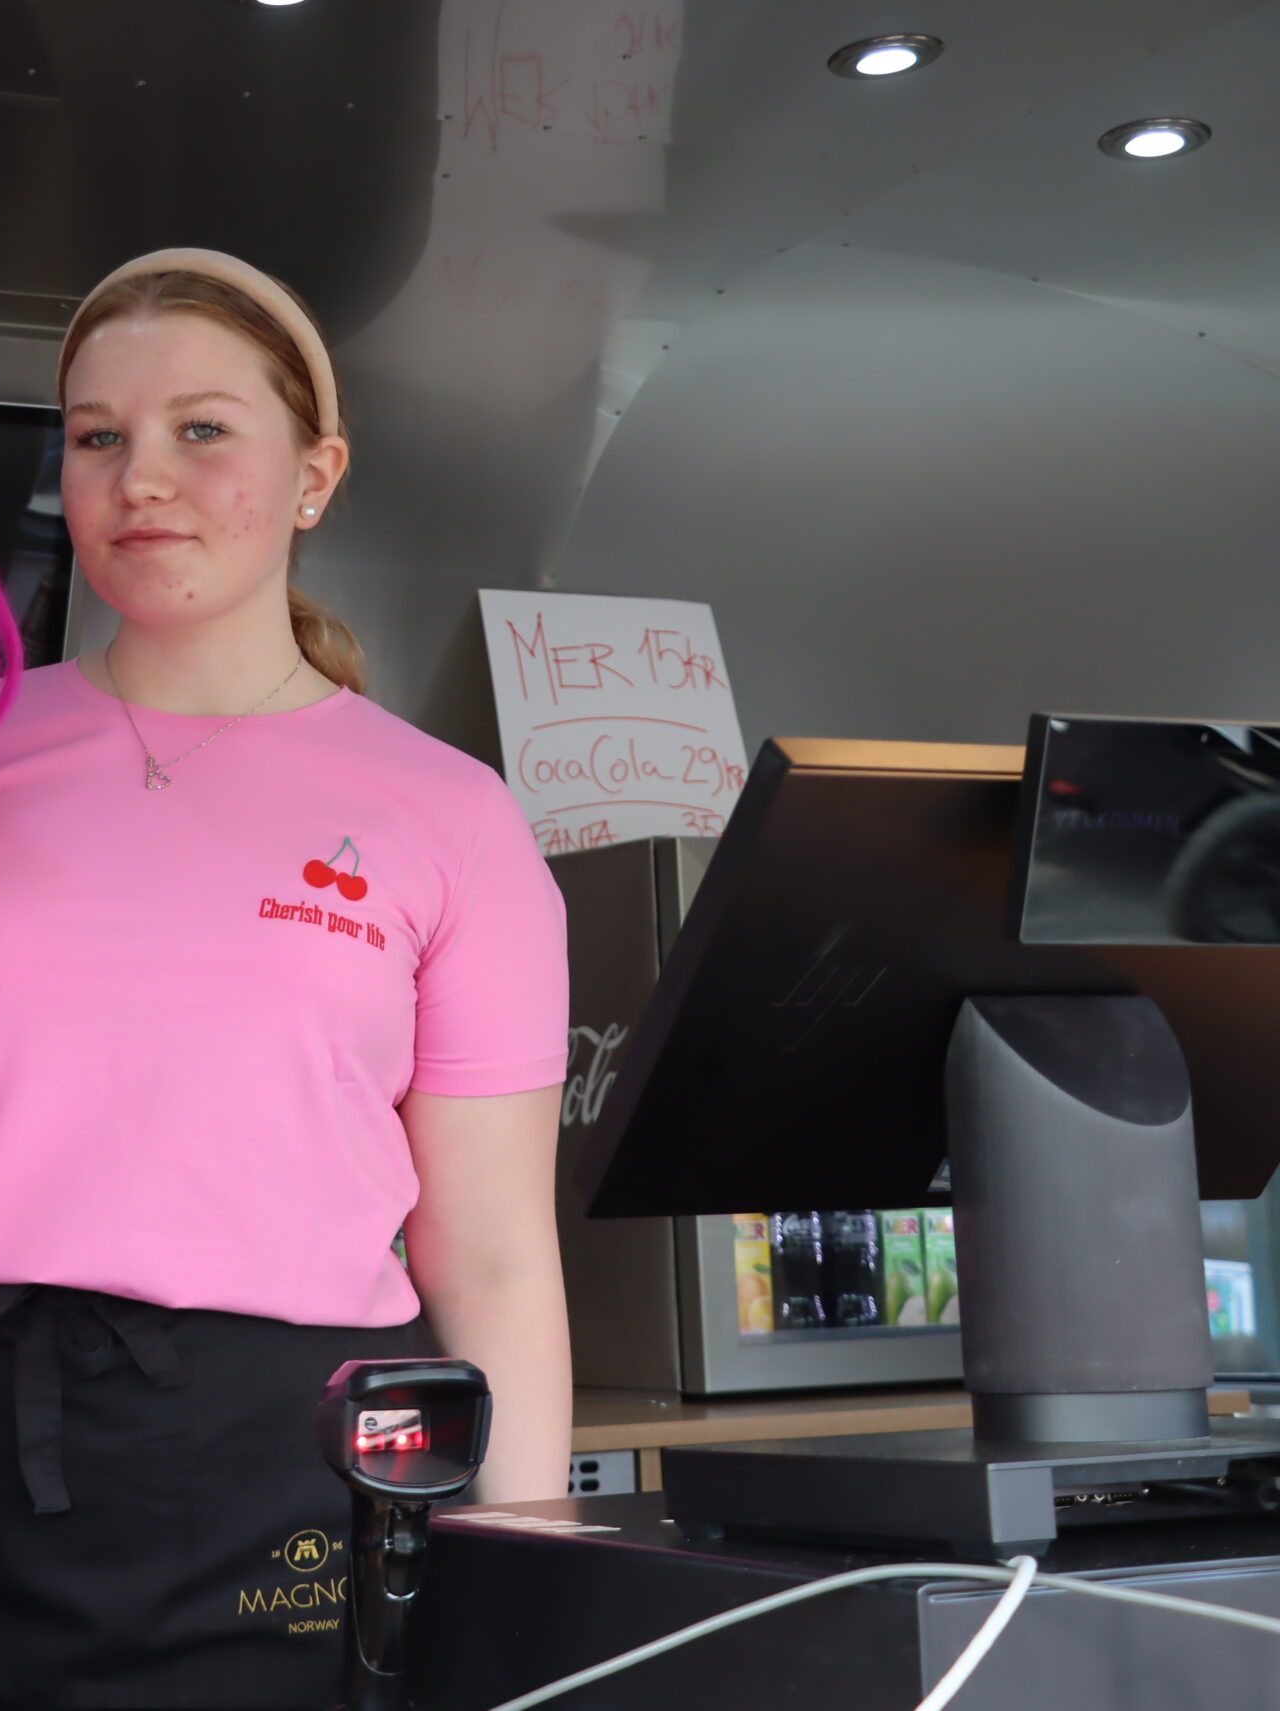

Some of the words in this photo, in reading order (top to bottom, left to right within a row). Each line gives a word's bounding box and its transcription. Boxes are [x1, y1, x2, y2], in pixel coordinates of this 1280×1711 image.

[506, 611, 634, 705] MER
[259, 898, 323, 925] Cherish
[327, 911, 362, 938] your
[366, 921, 386, 951] life
[288, 1619, 340, 1634] NORWAY
